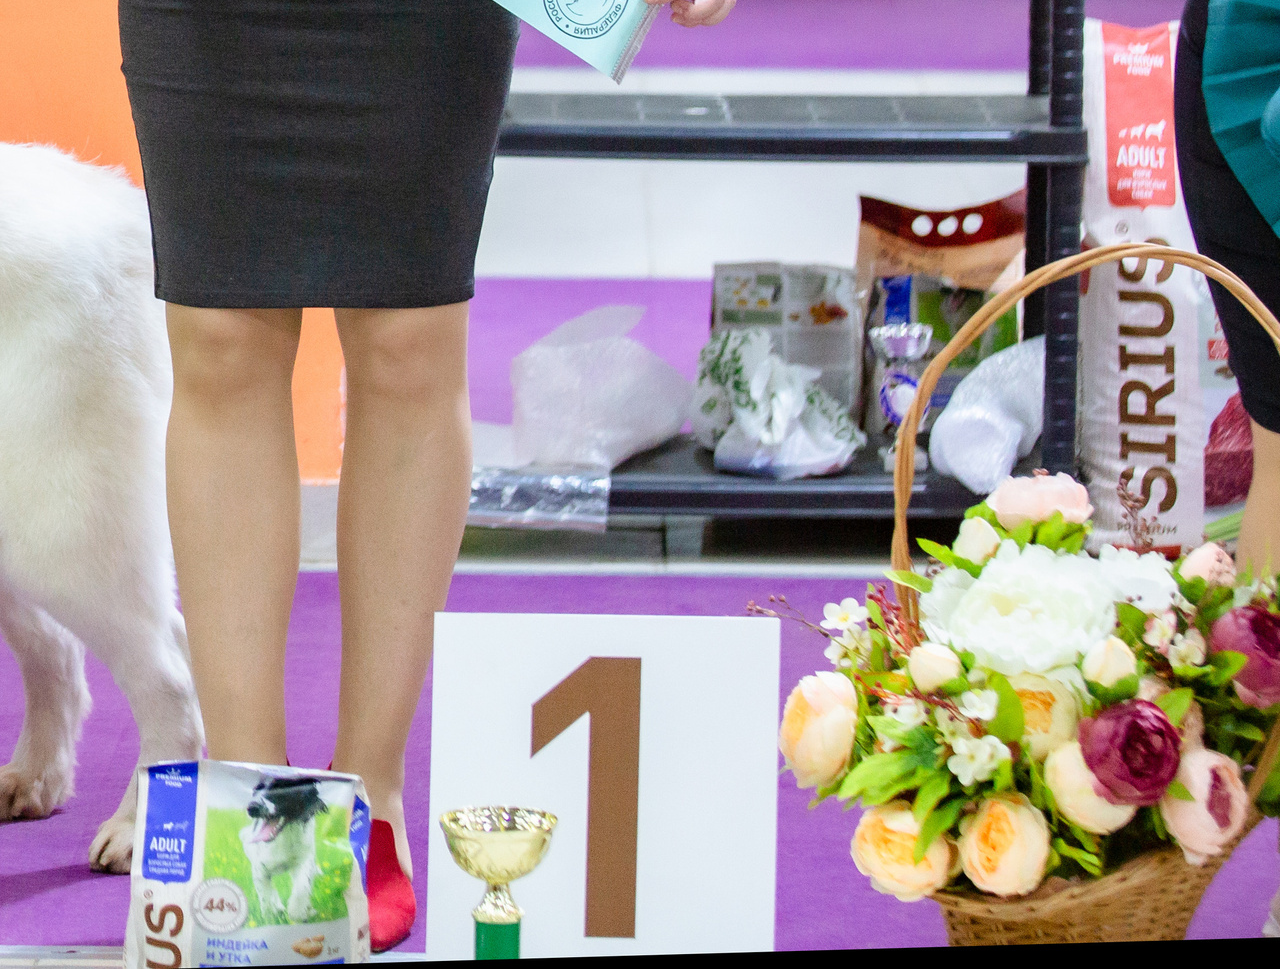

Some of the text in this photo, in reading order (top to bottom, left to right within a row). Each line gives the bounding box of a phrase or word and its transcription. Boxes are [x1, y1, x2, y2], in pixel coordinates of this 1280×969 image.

[573, 3, 622, 36] ФЕДЕРАЦИЯ
[1116, 144, 1167, 169] ADULT
[1117, 237, 1178, 514] SIRIUS
[530, 656, 643, 938] 1
[149, 836, 188, 854] ADULT
[203, 897, 238, 913] 44%
[206, 937, 269, 951] ИНДЕЙКА
[206, 950, 252, 964] И УТКА
